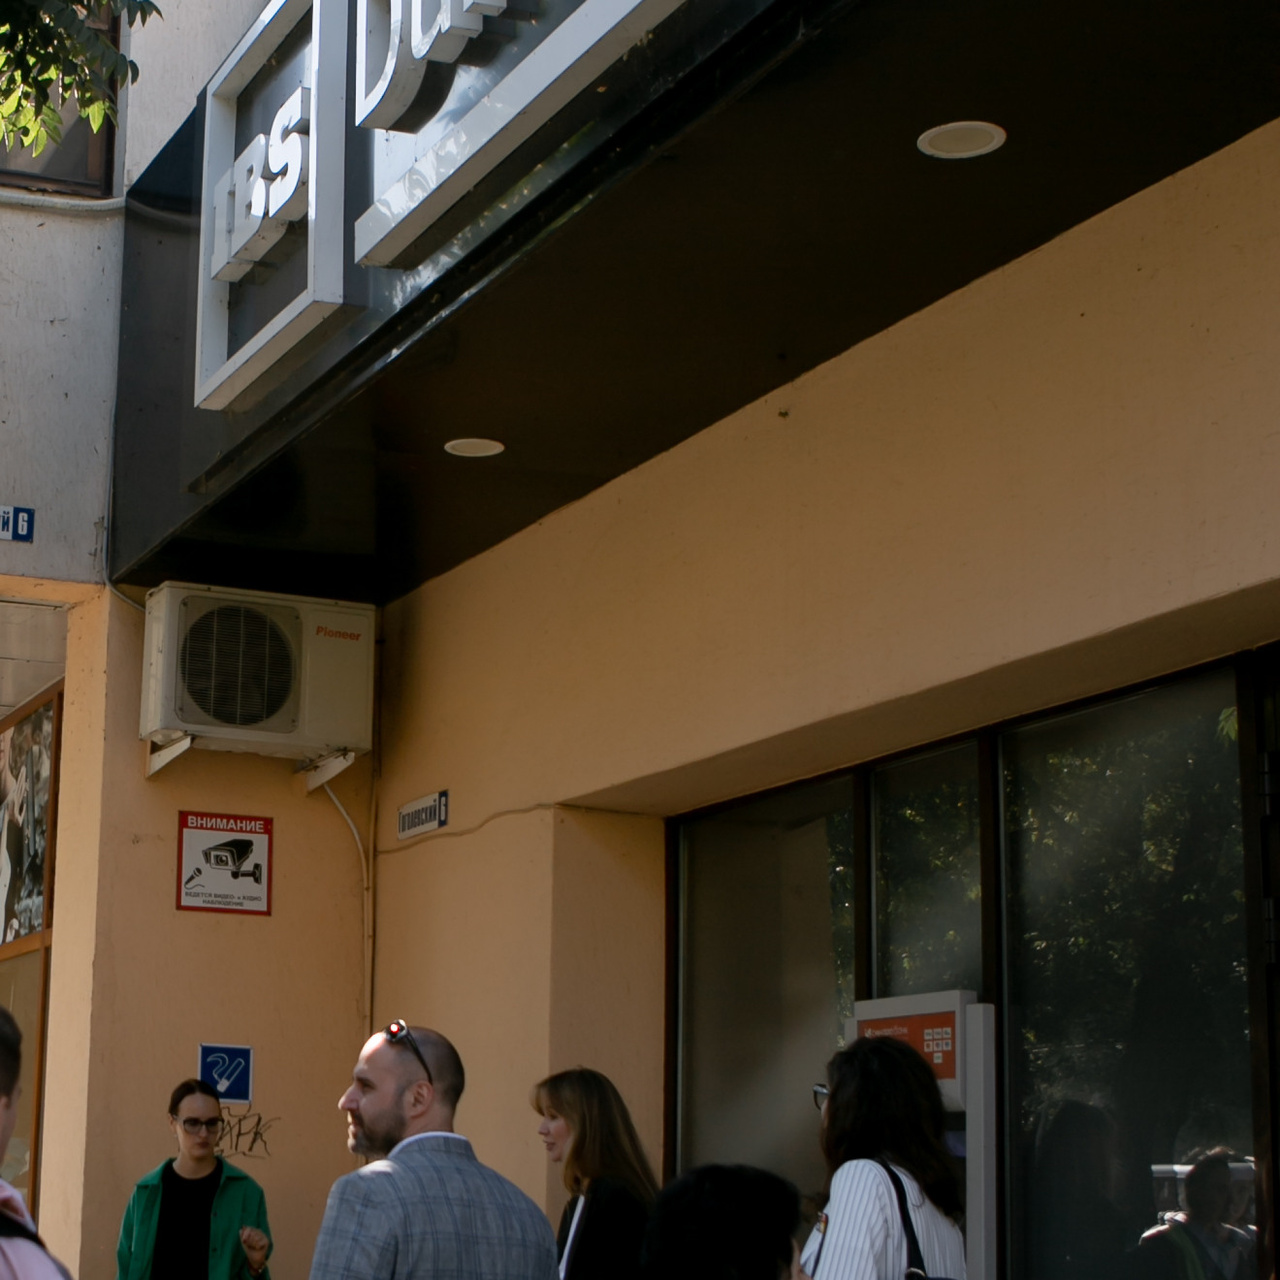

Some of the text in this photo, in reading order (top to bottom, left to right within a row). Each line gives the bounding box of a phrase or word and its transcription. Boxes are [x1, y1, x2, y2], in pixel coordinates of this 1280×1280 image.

[18, 512, 29, 535] 6
[315, 625, 362, 641] Pioneer
[187, 815, 264, 832] ВНИМАНИЕ
